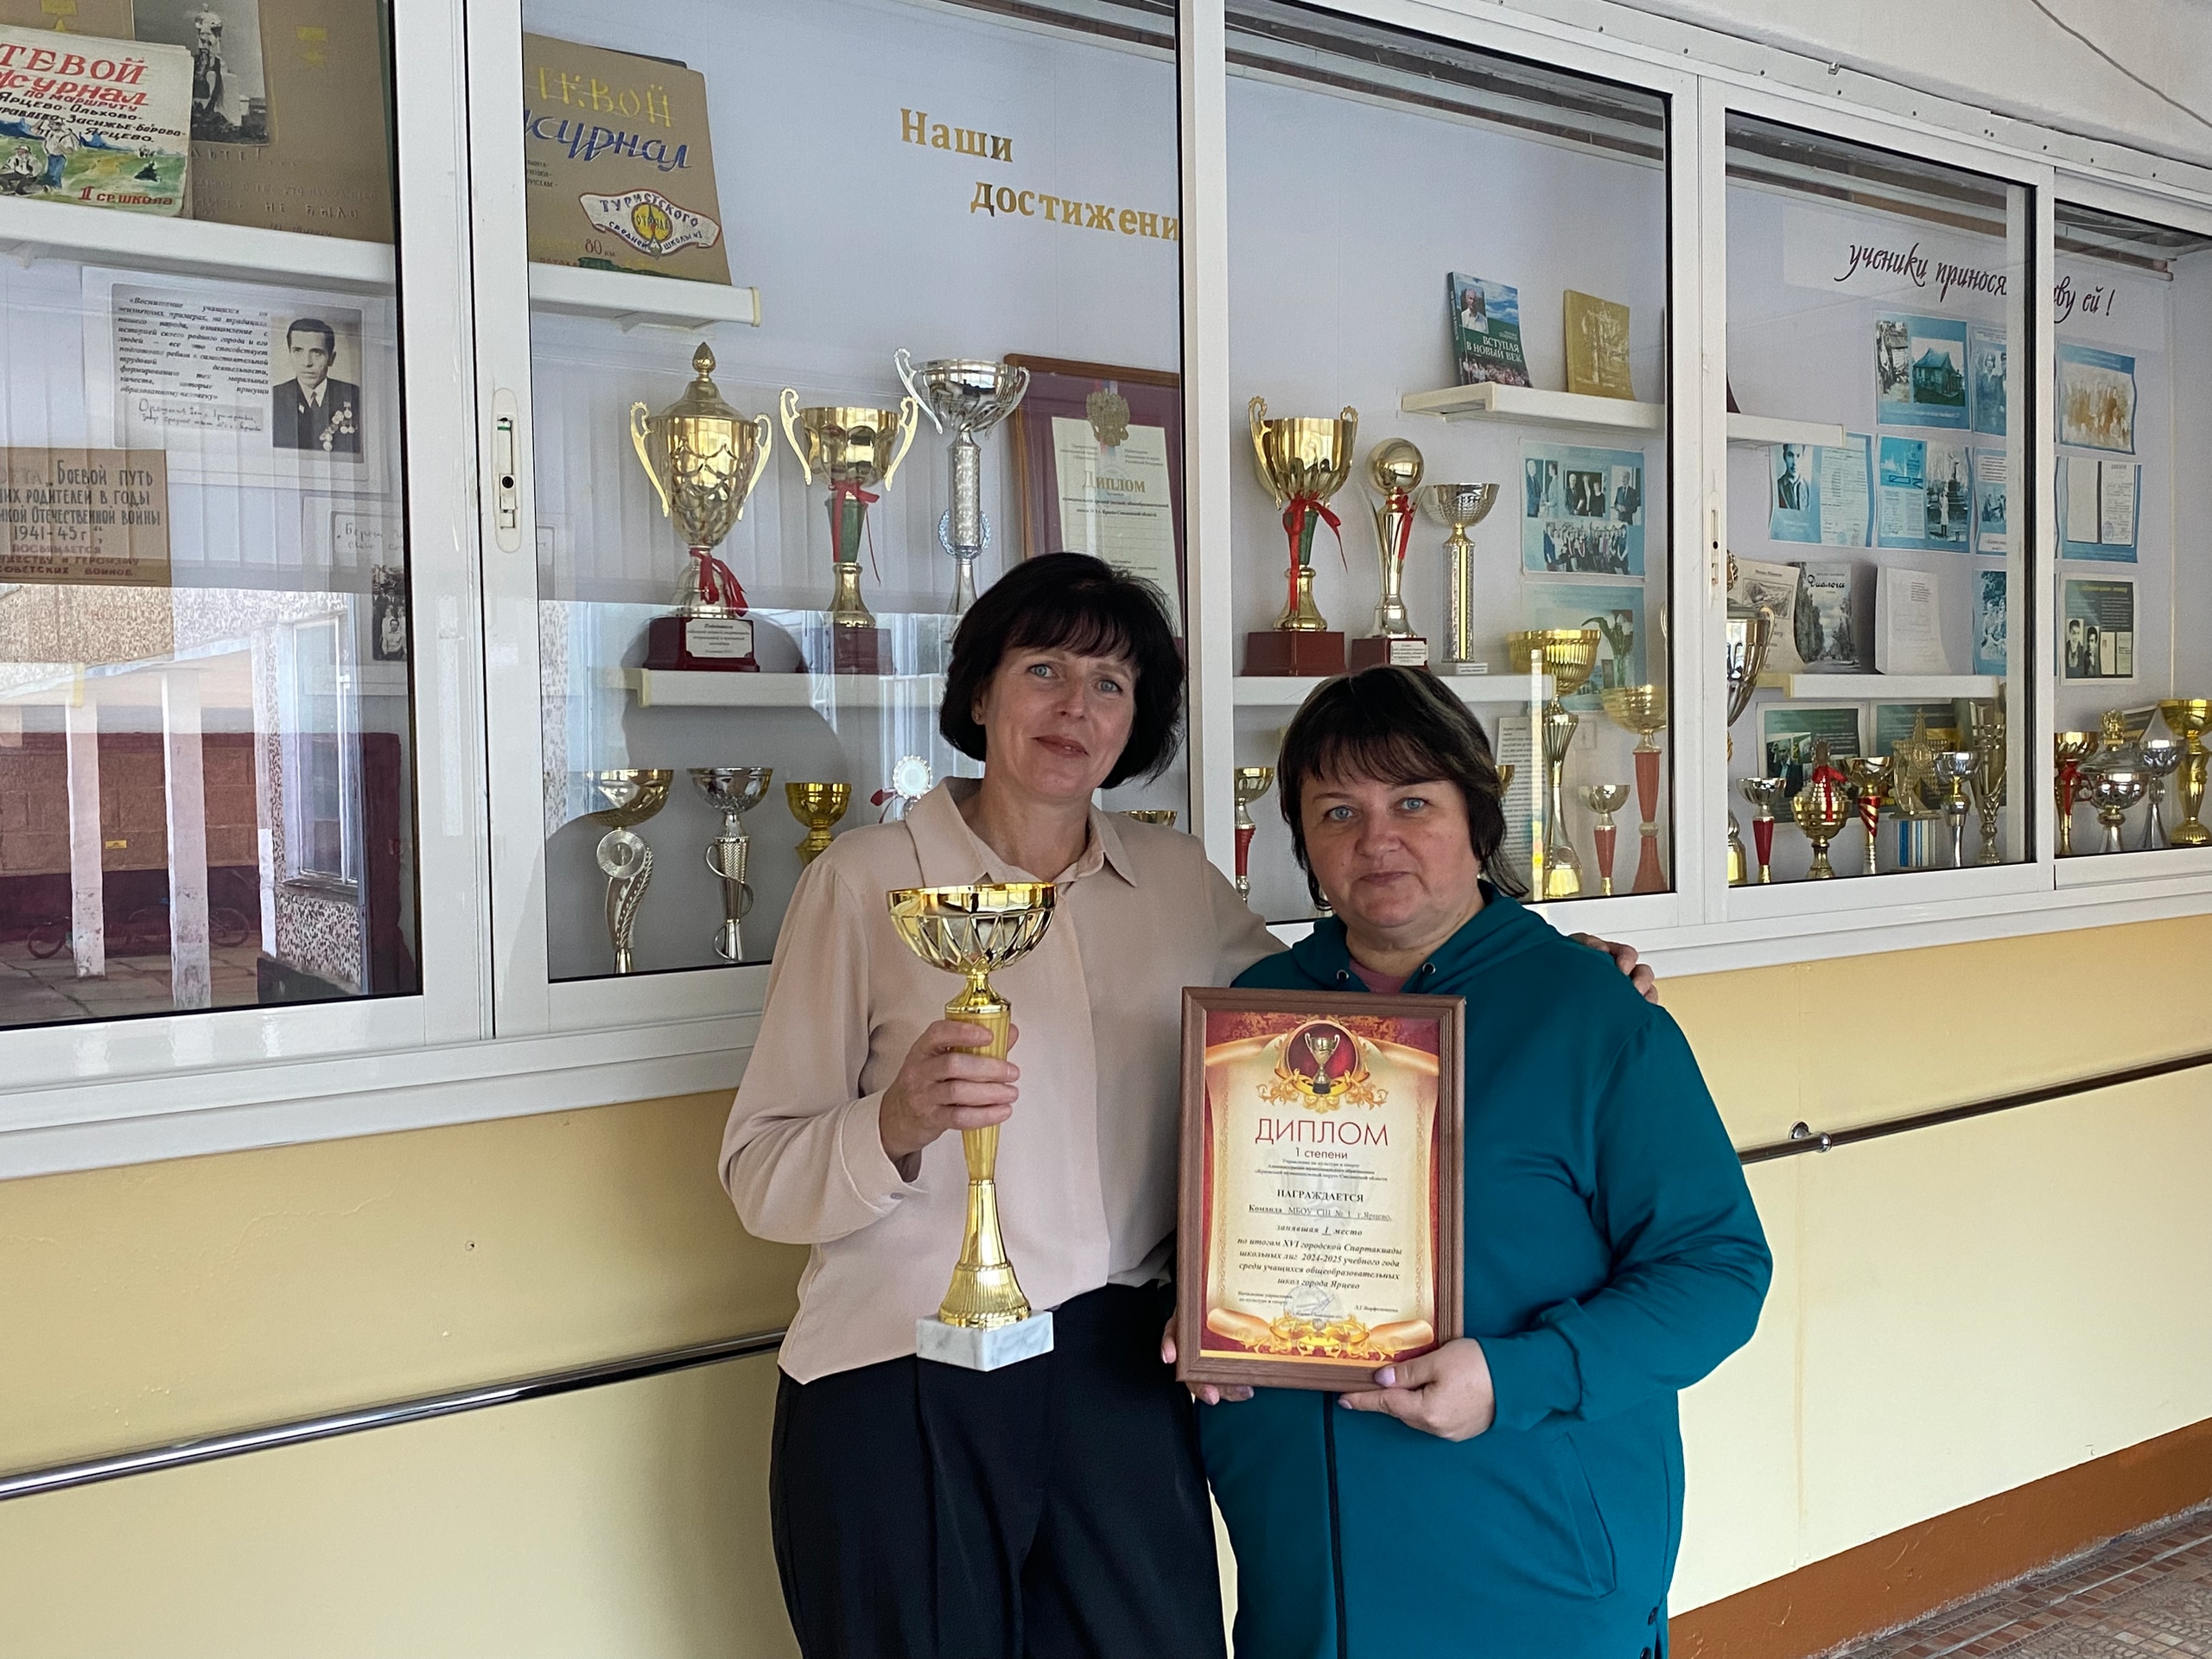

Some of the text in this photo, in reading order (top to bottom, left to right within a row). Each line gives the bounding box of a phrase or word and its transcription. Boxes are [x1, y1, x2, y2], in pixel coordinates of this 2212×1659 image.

[900, 108, 1014, 162] Наши
[600, 193, 698, 227] ТУРИСТСКОГО
[584, 238, 602, 255] 80
[1834, 242, 1928, 287] ученики
[1466, 341, 1471, 351] В
[1483, 335, 1519, 353] ВСТУПАЯ
[119, 469, 153, 486] ПУТЬ
[1255, 1118, 1389, 1147] ДИПЛОМ
[1304, 1149, 1348, 1160] степени
[1277, 1189, 1363, 1202] НАГРАЖДАЕТСЯ
[1249, 1205, 1282, 1213] Команда
[1288, 1206, 1312, 1215] МБОУ
[1300, 1243, 1342, 1251] городской
[1344, 1243, 1402, 1255] Спартакиады
[1301, 1255, 1342, 1263] 2024-2025
[1343, 1256, 1380, 1267] учебного
[1238, 1262, 1401, 1281] среди учащихся общеобразовательных
[1301, 1280, 1329, 1288] города
[1331, 1281, 1360, 1289] Ярцево
